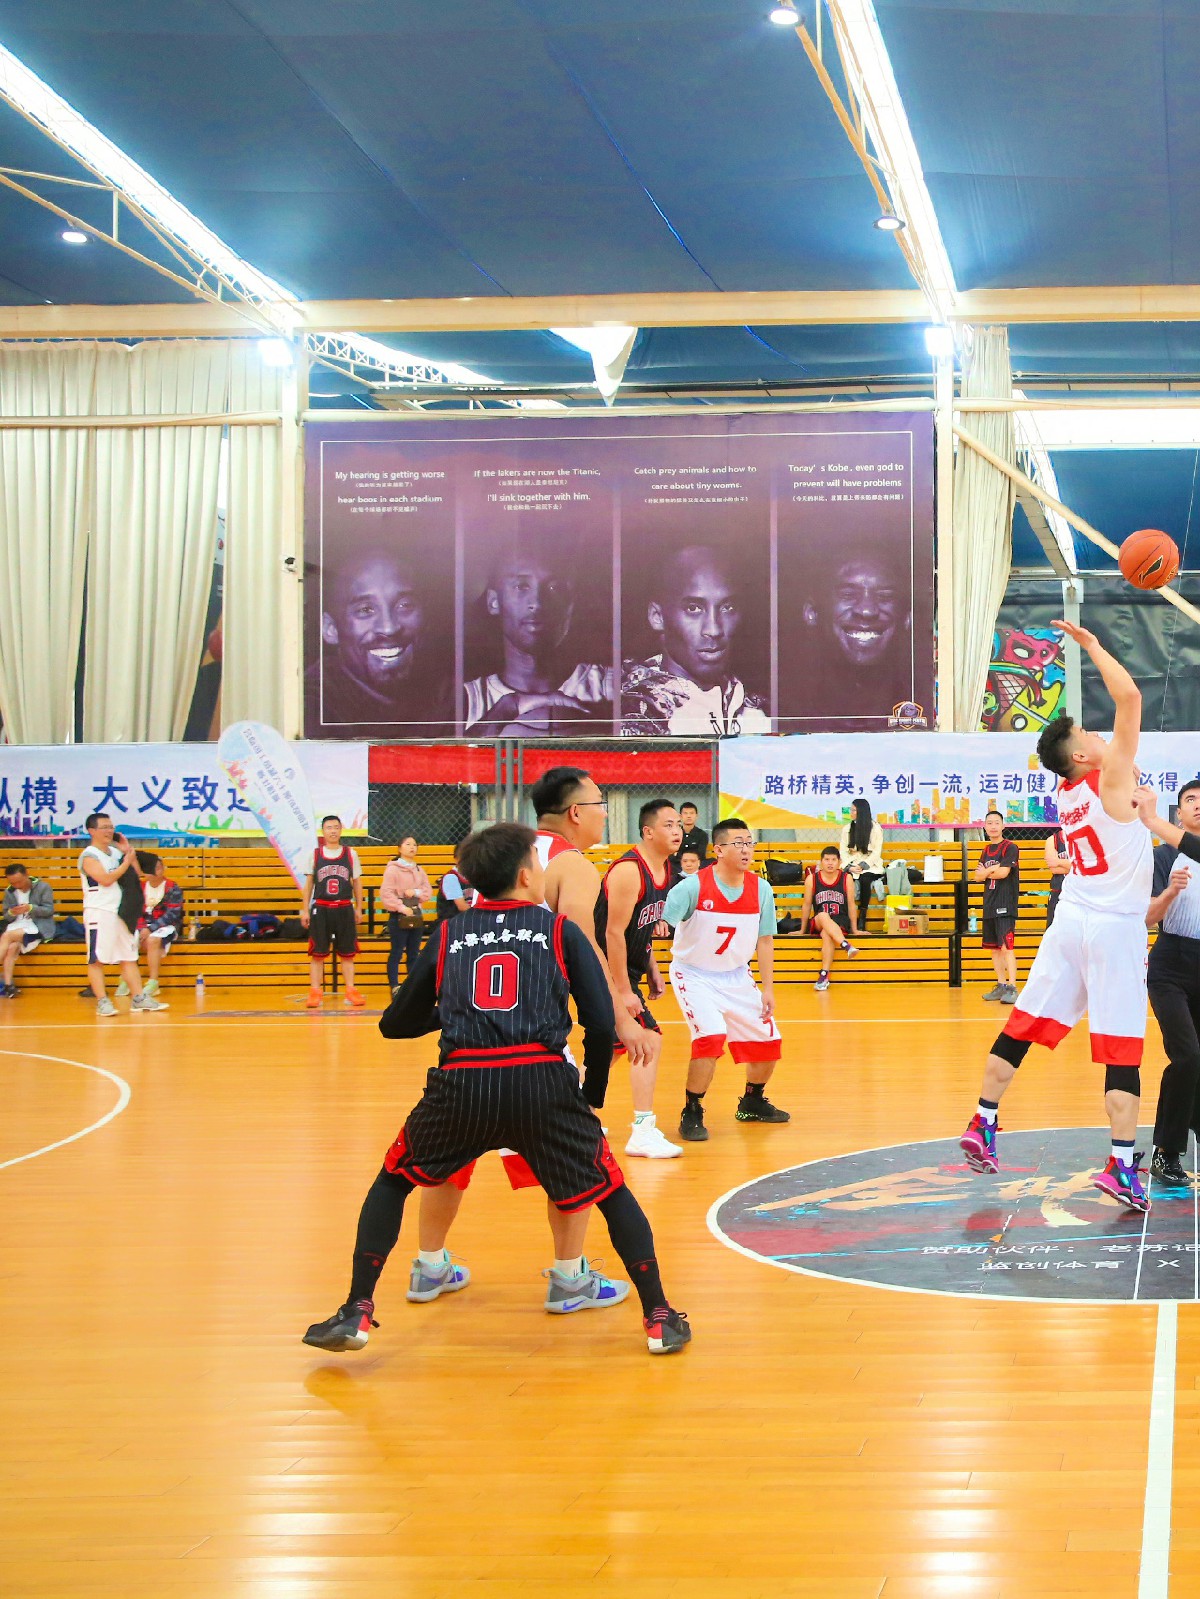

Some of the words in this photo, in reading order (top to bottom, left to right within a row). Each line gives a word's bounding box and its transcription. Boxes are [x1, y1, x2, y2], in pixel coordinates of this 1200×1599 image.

[634, 466, 657, 475] Catch
[659, 468, 677, 476] prey
[679, 466, 710, 474] animals
[712, 466, 727, 474] and
[728, 465, 747, 473] how
[894, 463, 904, 471] to
[335, 471, 349, 481] My
[350, 471, 381, 480] hearing
[382, 471, 389, 479] is
[390, 471, 420, 480] getting
[482, 469, 496, 477] the
[557, 469, 571, 477] the
[670, 481, 695, 490] about
[696, 481, 711, 491] tiny
[793, 480, 824, 488] prevent
[826, 479, 841, 487] will
[842, 479, 862, 487] have
[863, 478, 902, 488] problems
[379, 495, 387, 503] in
[388, 495, 409, 503] each
[410, 495, 443, 503] stadium
[499, 493, 516, 501] sink
[517, 492, 553, 502] together
[553, 492, 572, 501] with
[327, 878, 339, 895] 6
[715, 925, 738, 956] 7
[472, 951, 520, 1012] 0
